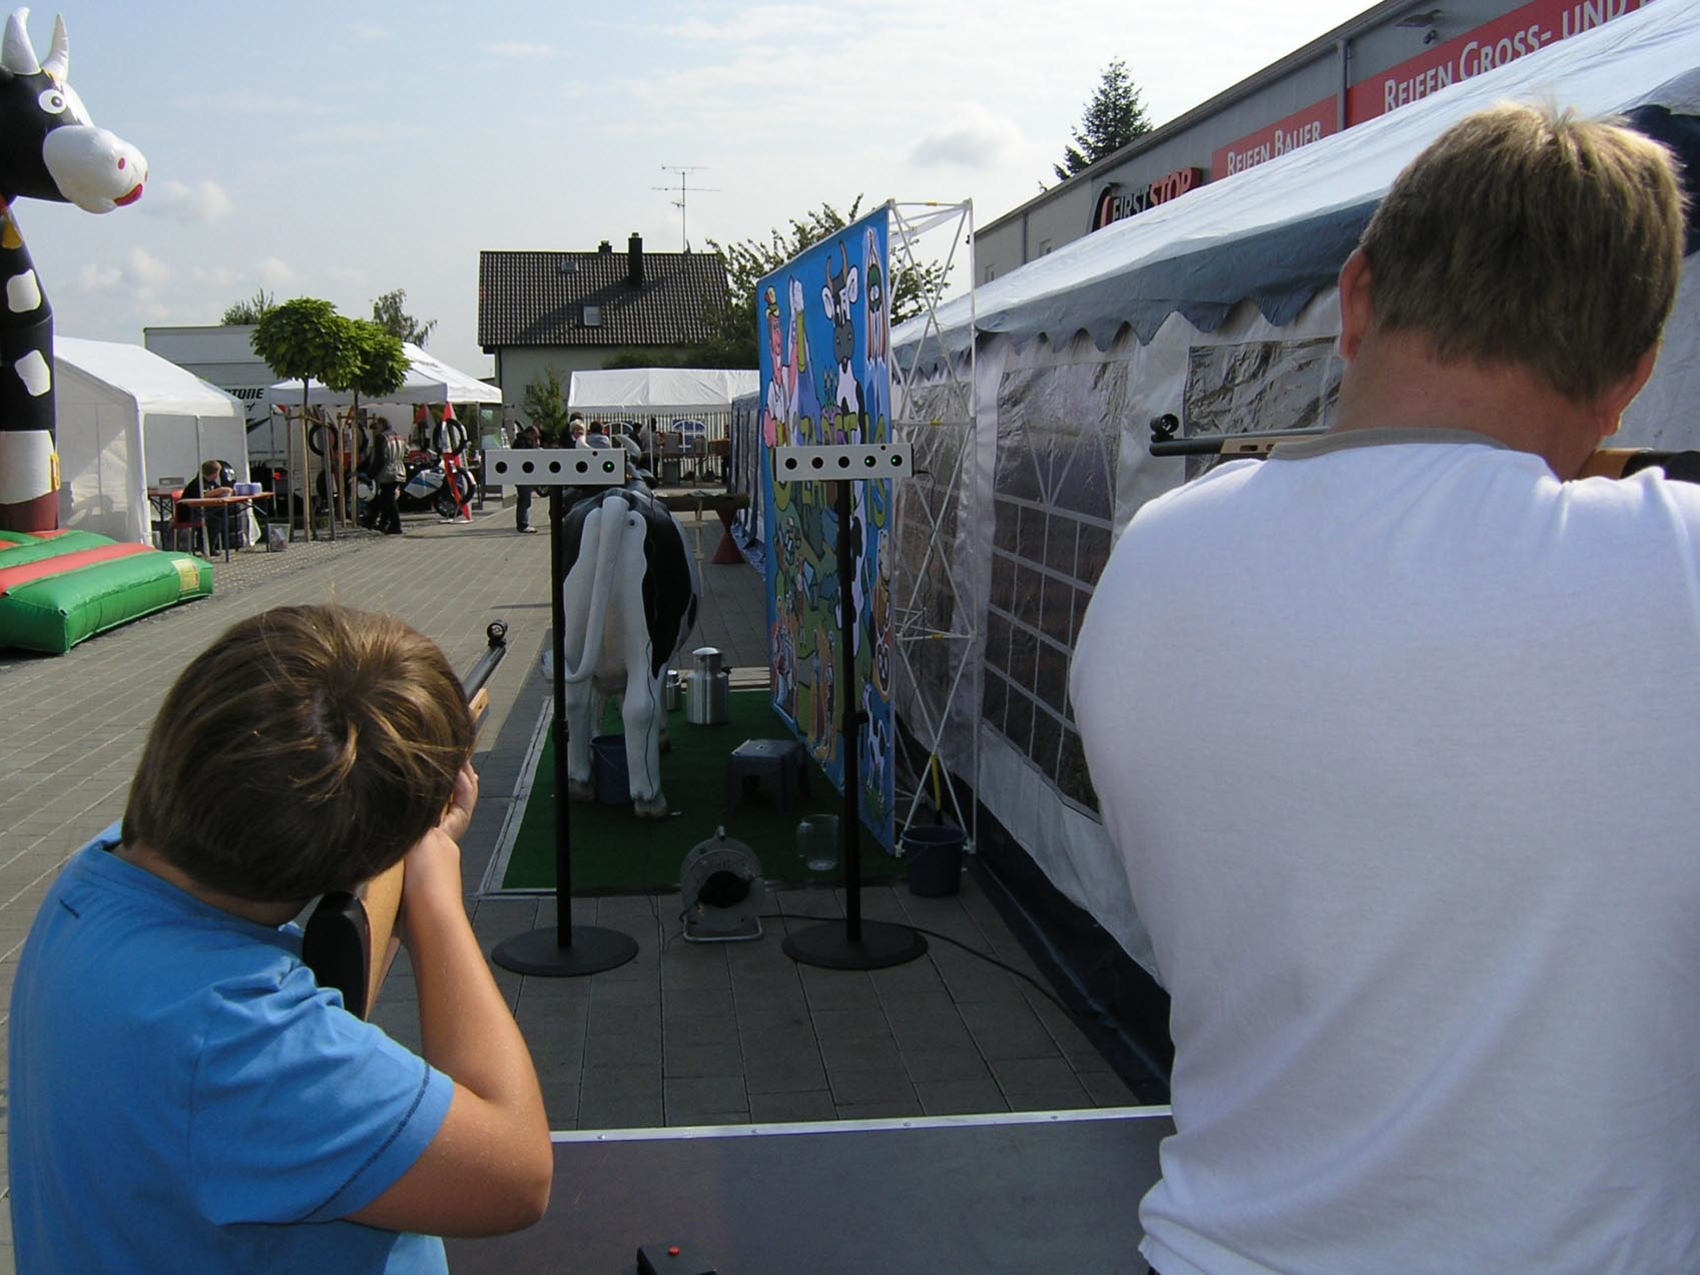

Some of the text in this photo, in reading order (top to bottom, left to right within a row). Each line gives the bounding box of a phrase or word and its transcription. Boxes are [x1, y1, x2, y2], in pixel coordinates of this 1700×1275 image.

[1384, 0, 1628, 114] REIFEN GROSS- UND
[1227, 121, 1321, 176] REIFEN BAUER
[1112, 167, 1193, 222] FIRST STOP
